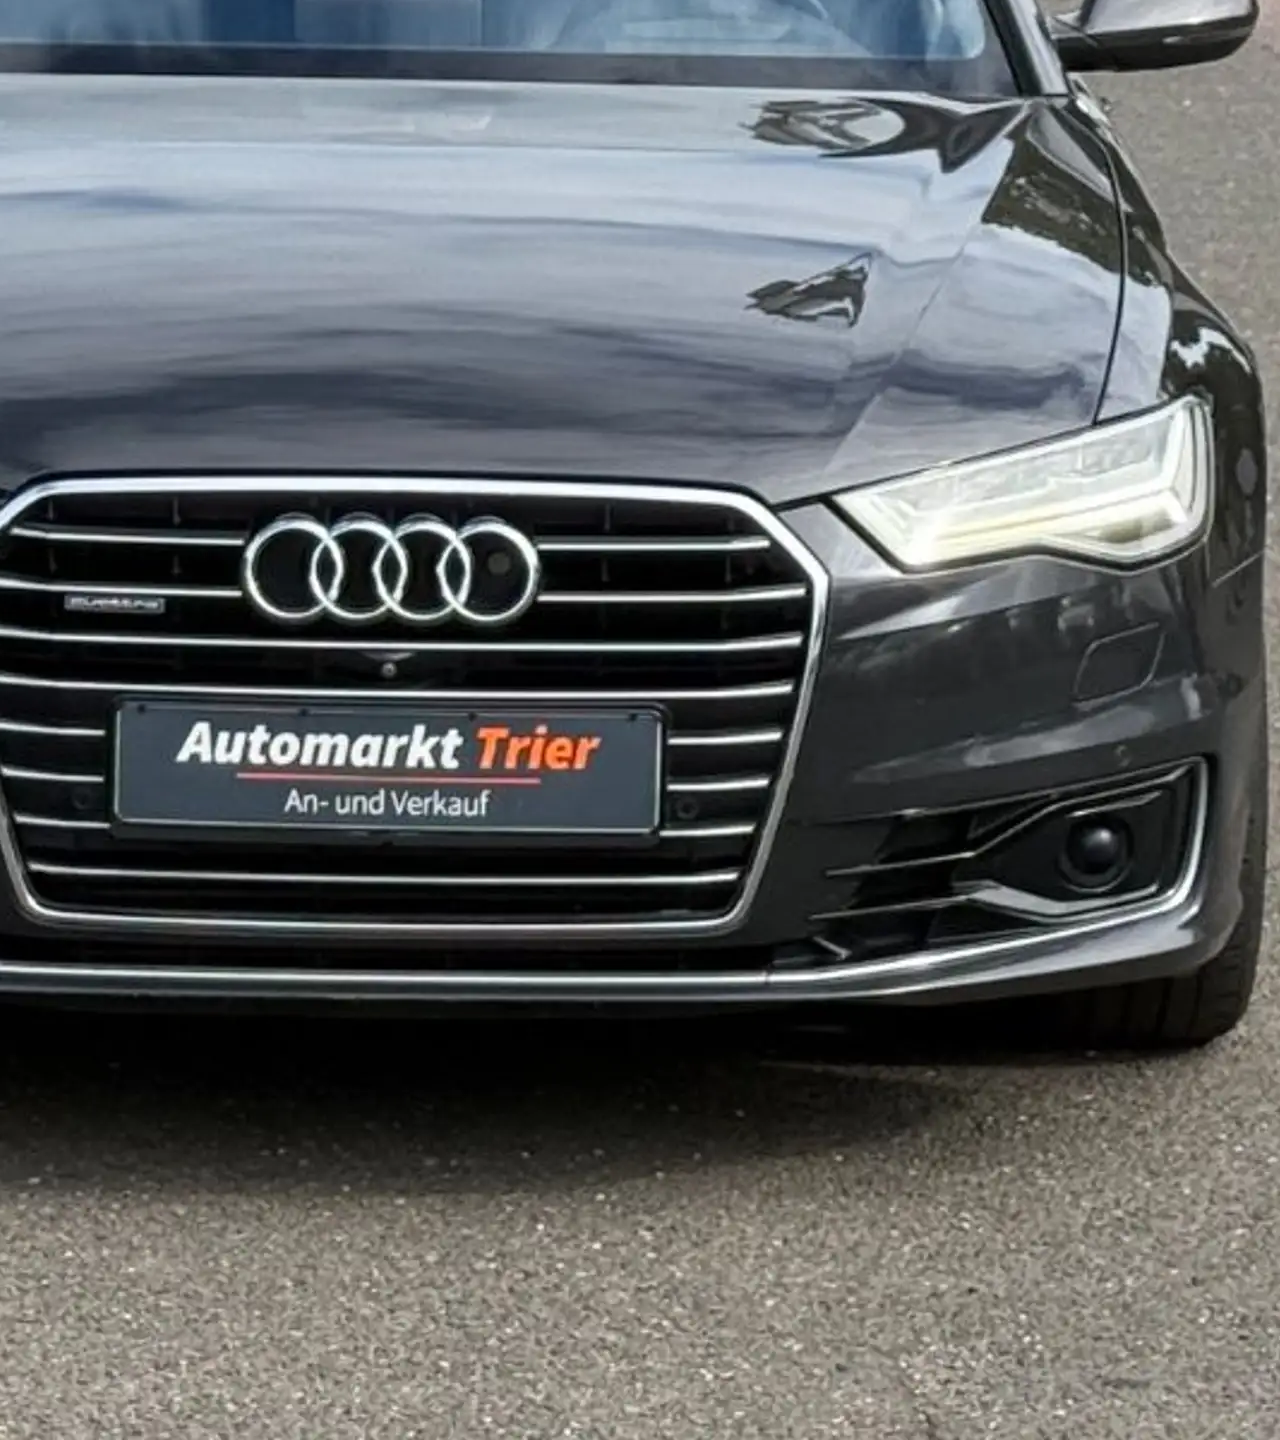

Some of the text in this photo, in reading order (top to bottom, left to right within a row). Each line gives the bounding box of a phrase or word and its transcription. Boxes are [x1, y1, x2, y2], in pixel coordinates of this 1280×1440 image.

[176, 720, 602, 771] Automarkt Trier
[284, 787, 492, 818] An- und Verkauf
